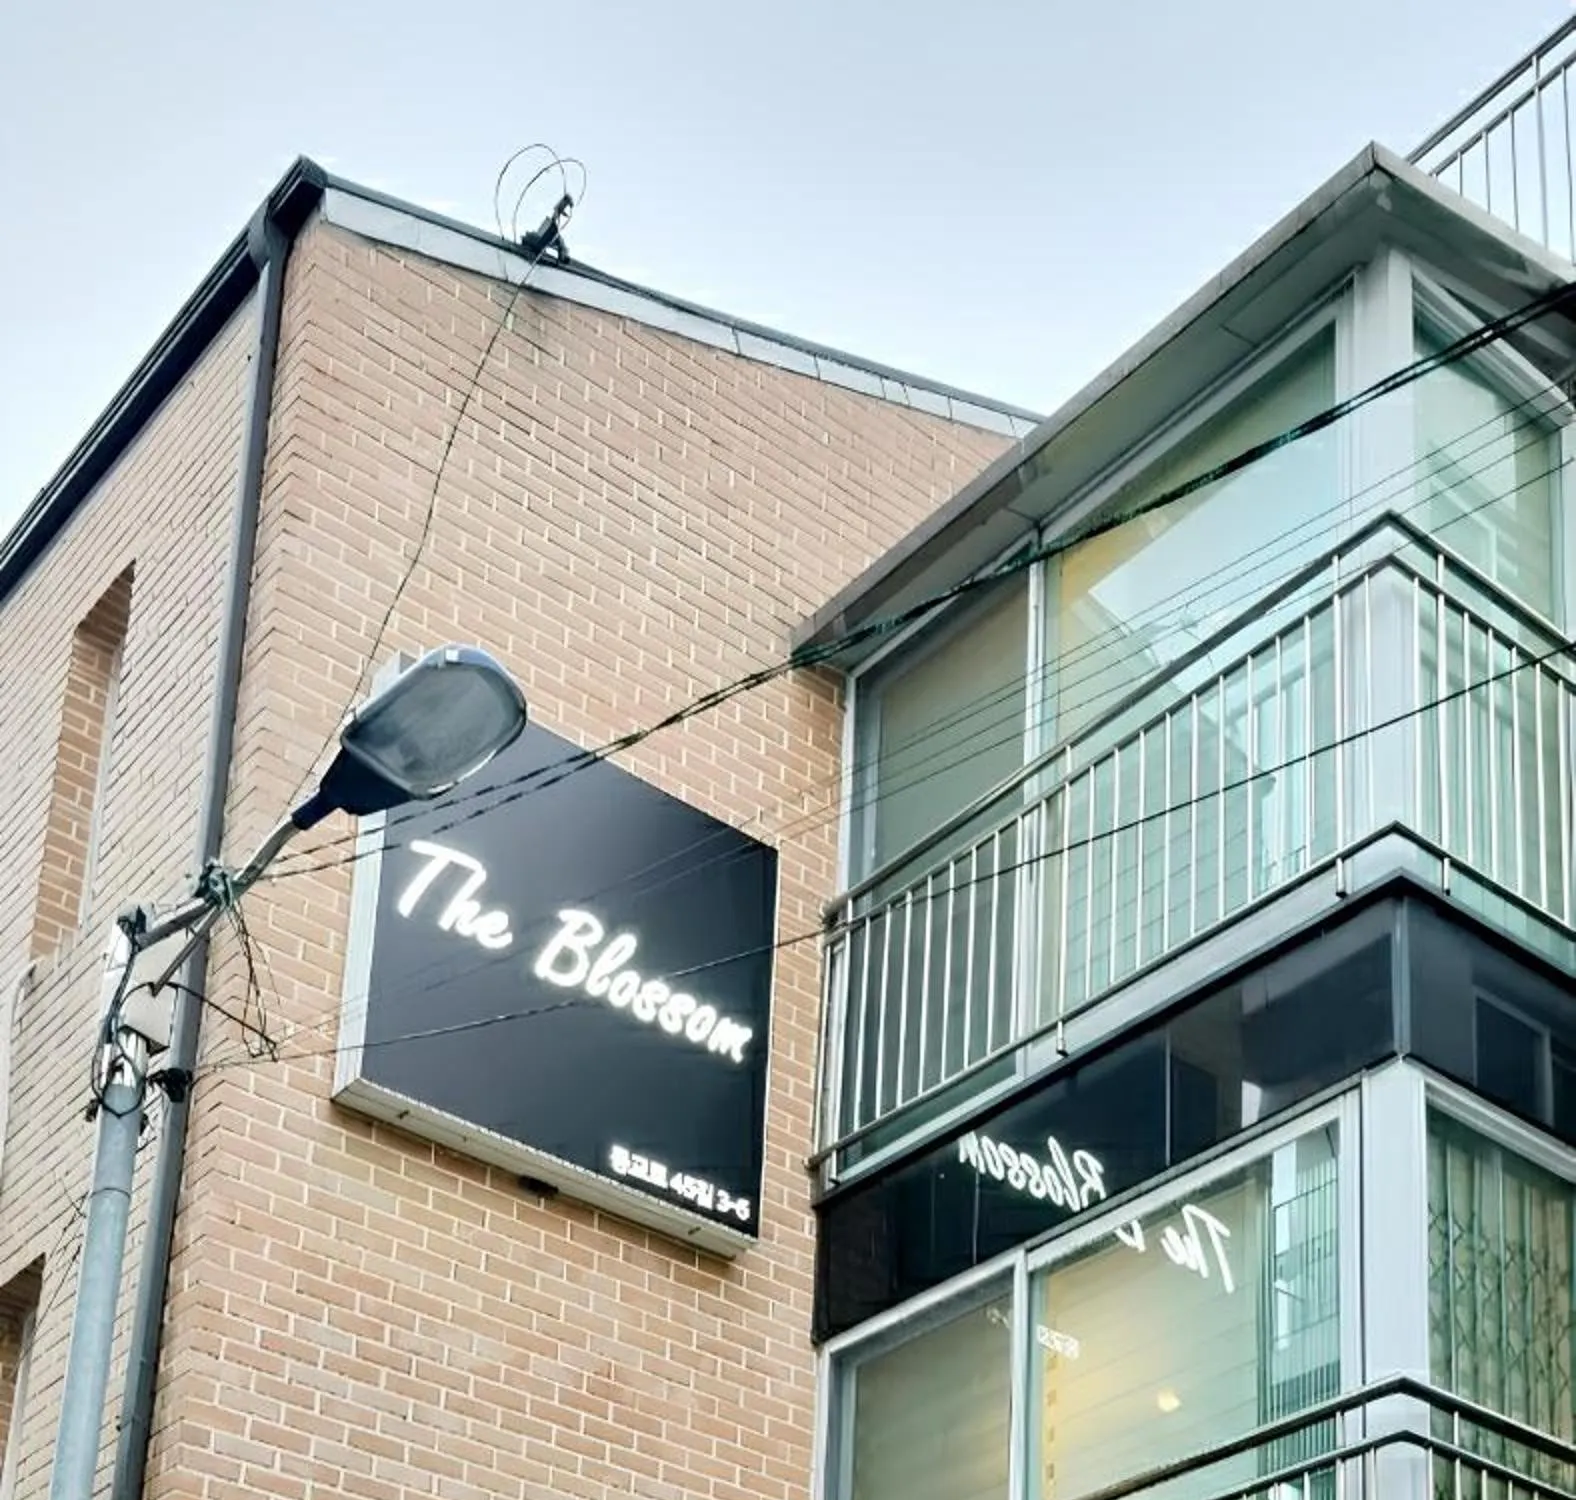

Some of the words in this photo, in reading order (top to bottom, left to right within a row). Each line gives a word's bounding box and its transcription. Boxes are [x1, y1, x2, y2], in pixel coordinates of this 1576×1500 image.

[396, 839, 513, 950] The
[533, 907, 754, 1065] Blossom
[716, 1188, 750, 1221] 3-6
